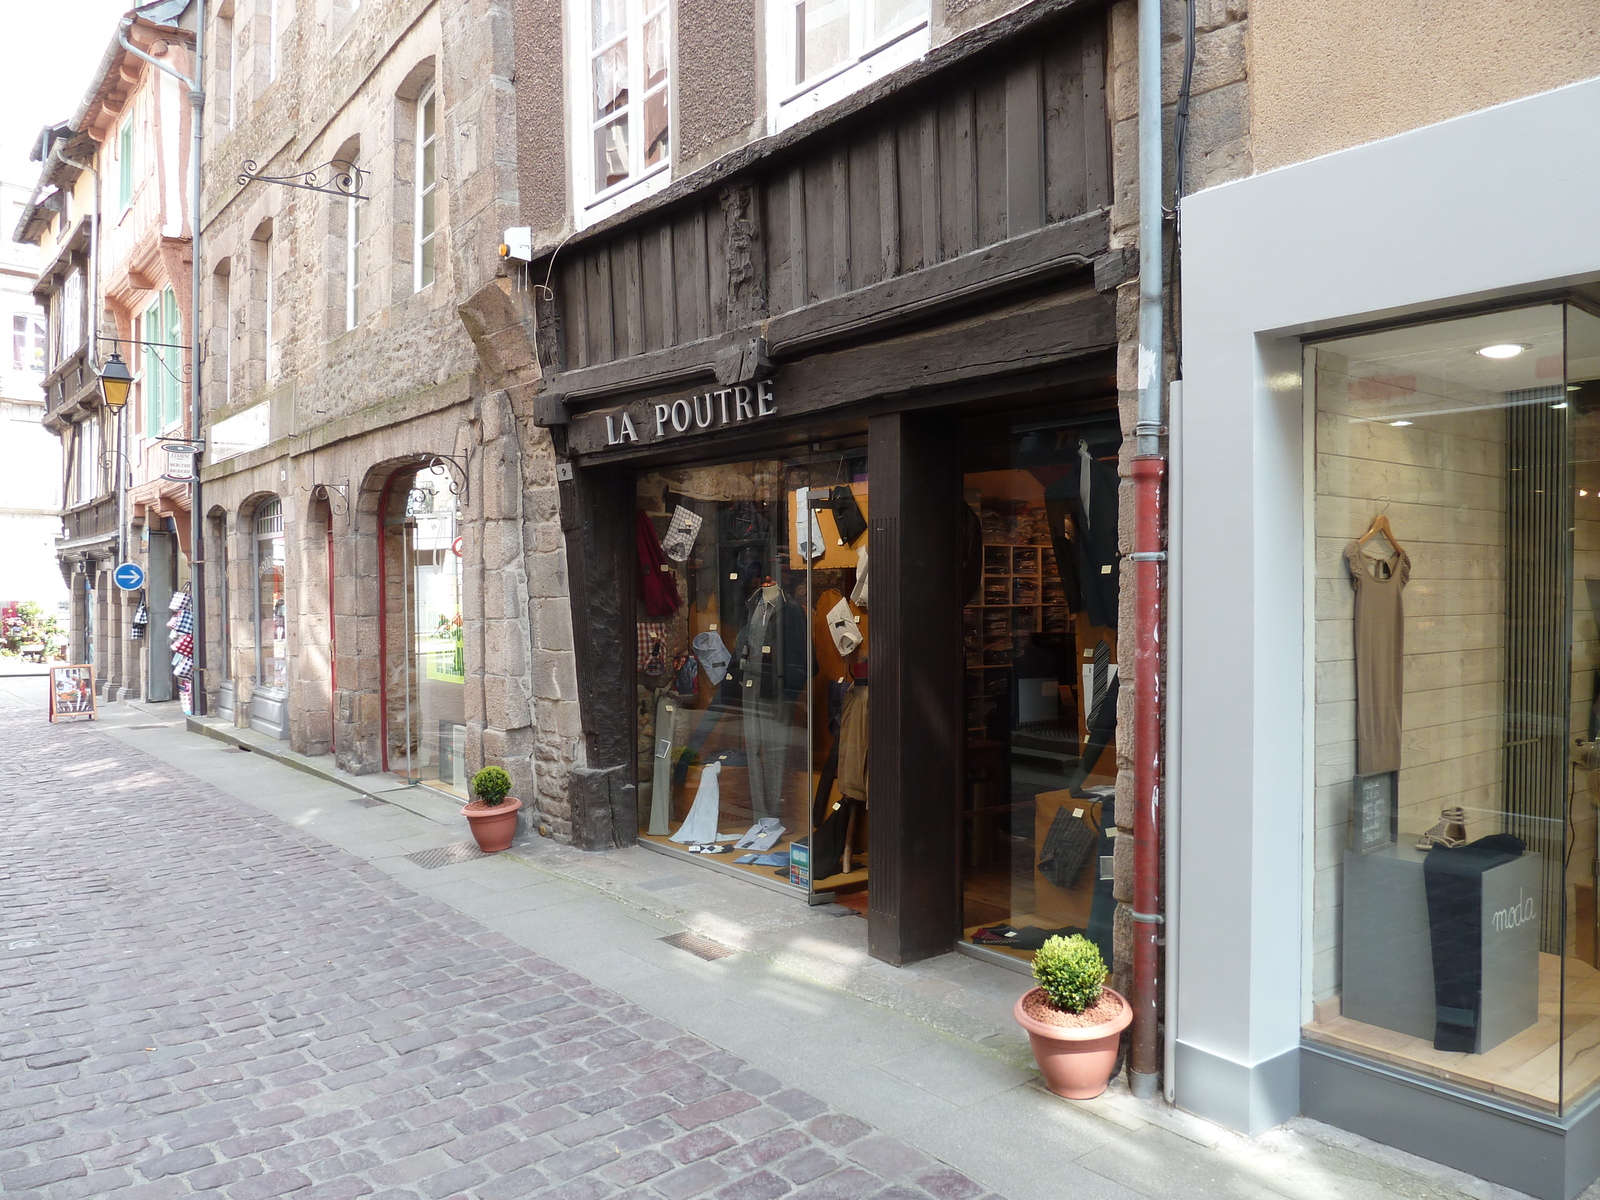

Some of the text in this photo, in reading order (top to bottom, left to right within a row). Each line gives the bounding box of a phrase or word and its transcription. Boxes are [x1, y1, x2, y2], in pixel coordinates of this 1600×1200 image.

[605, 380, 778, 445] LA POUTRE
[562, 468, 567, 476] 9
[1492, 887, 1536, 931] moda
